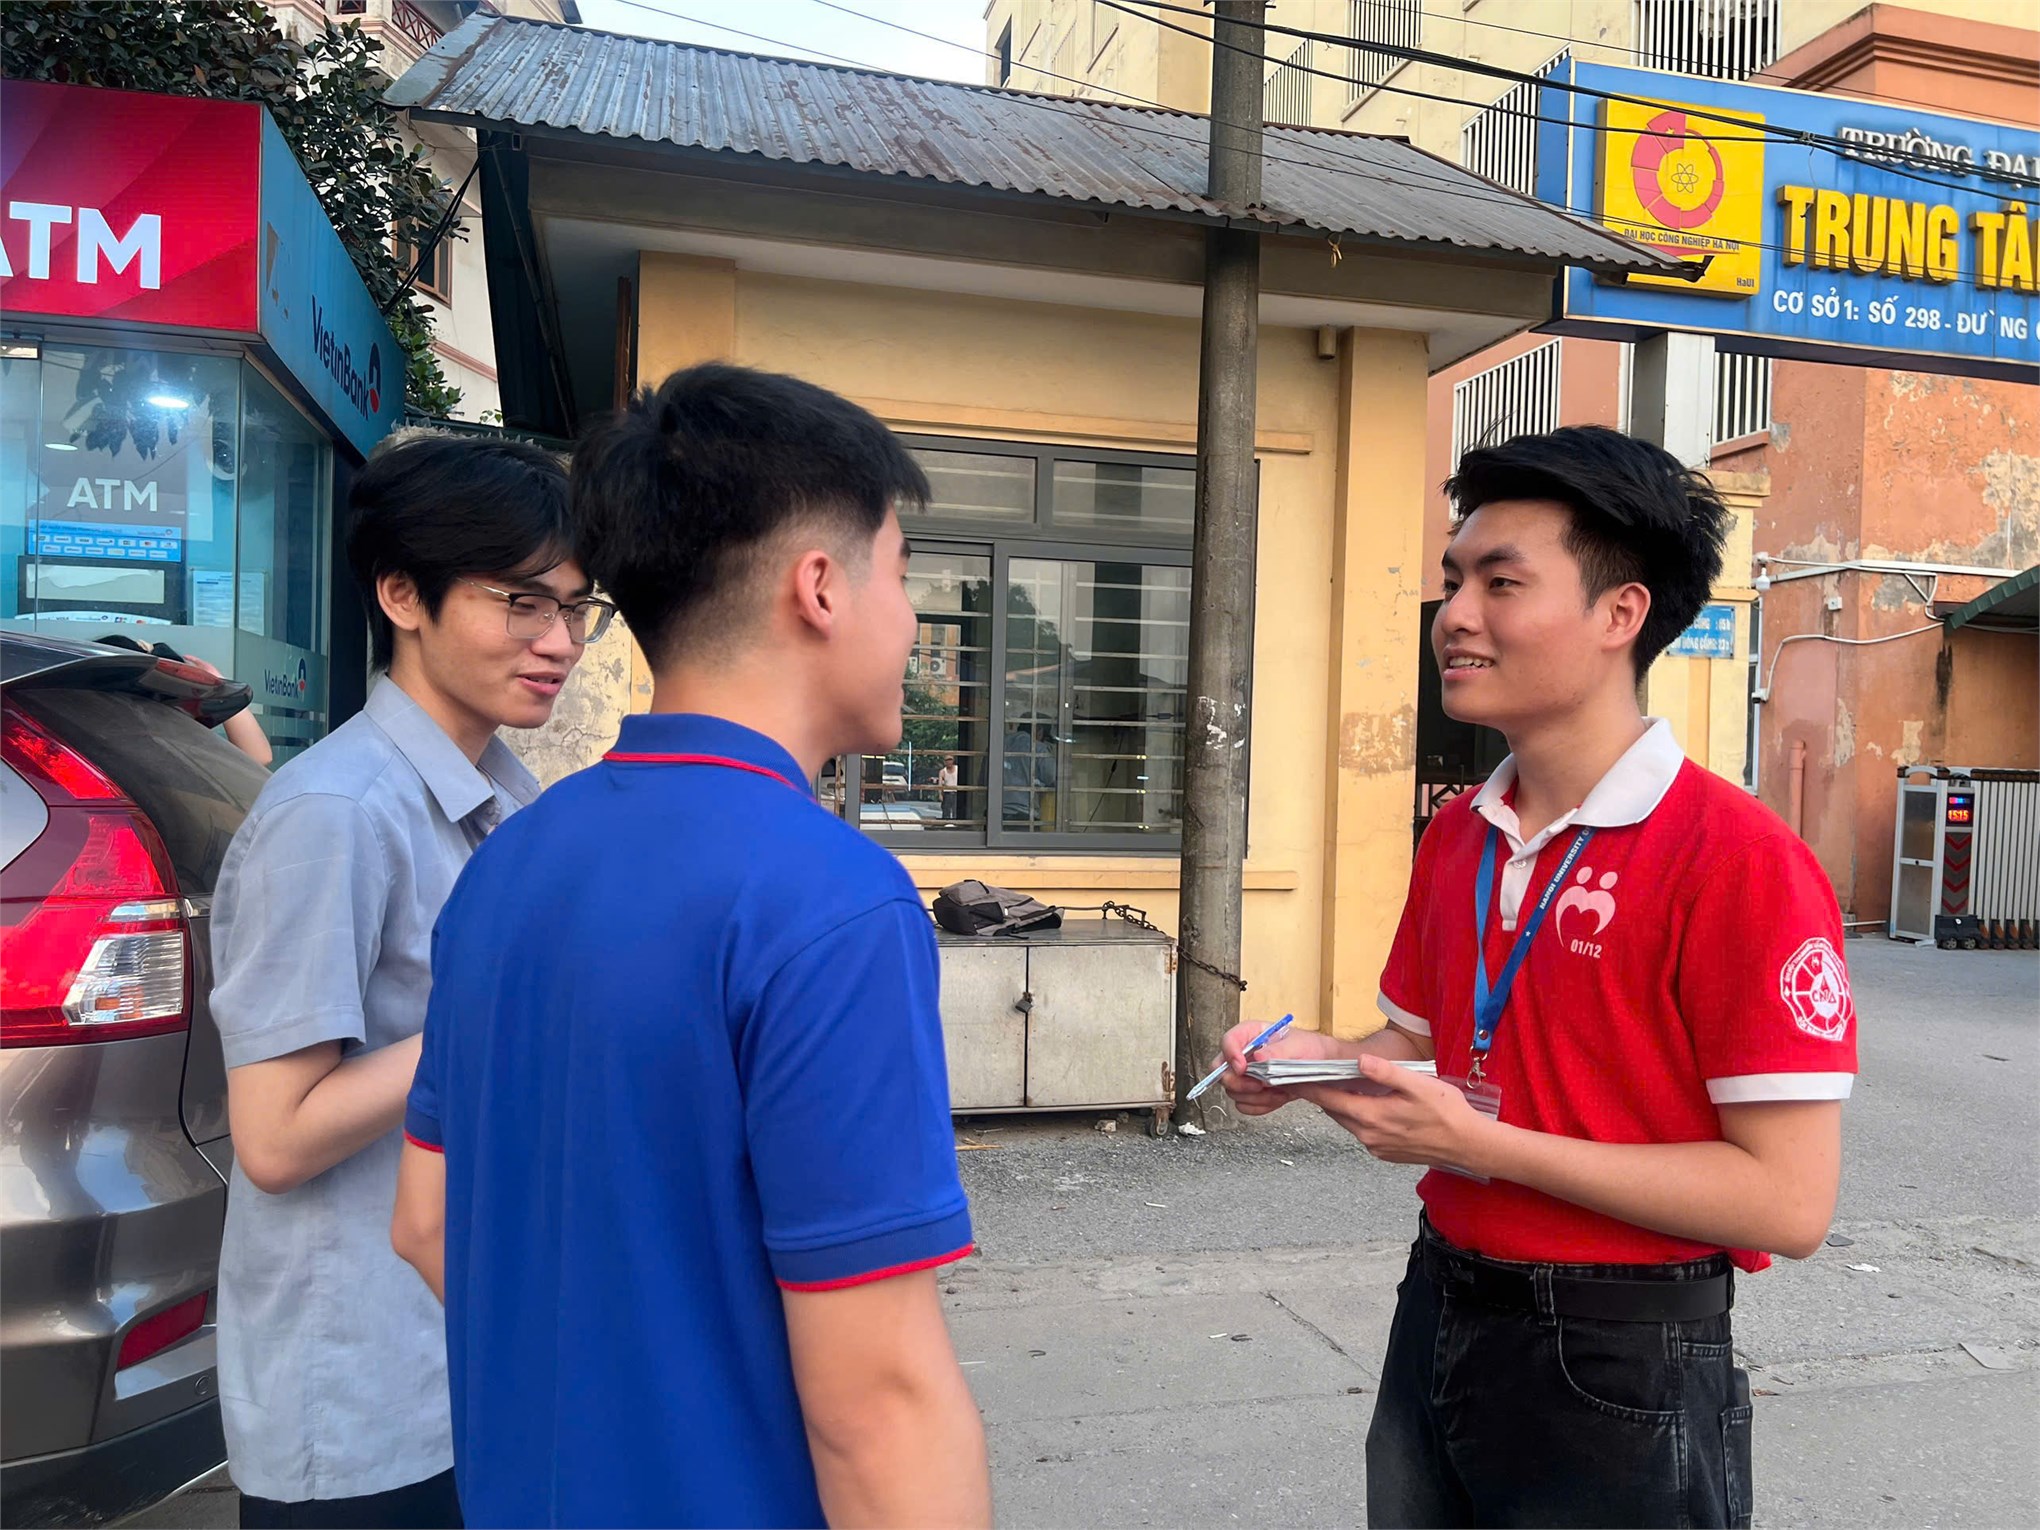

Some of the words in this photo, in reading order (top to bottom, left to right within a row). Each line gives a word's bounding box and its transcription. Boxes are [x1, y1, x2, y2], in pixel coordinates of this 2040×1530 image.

[1778, 185, 1960, 283] TRUNG
[1969, 200, 2040, 292] TÂ
[1737, 277, 1755, 288] HaUI
[1773, 289, 1804, 314] CƠ
[1811, 286, 1841, 319] SỞ
[1844, 299, 1860, 321] 1:
[1868, 295, 1899, 325] SỐ
[1905, 306, 1941, 330] 298
[311, 294, 368, 421] VietinBank
[66, 477, 158, 512] ATM
[1539, 883, 1556, 910] HANOI
[1553, 835, 1585, 883] UNIVERSITY
[1570, 938, 1603, 959] 01/12
